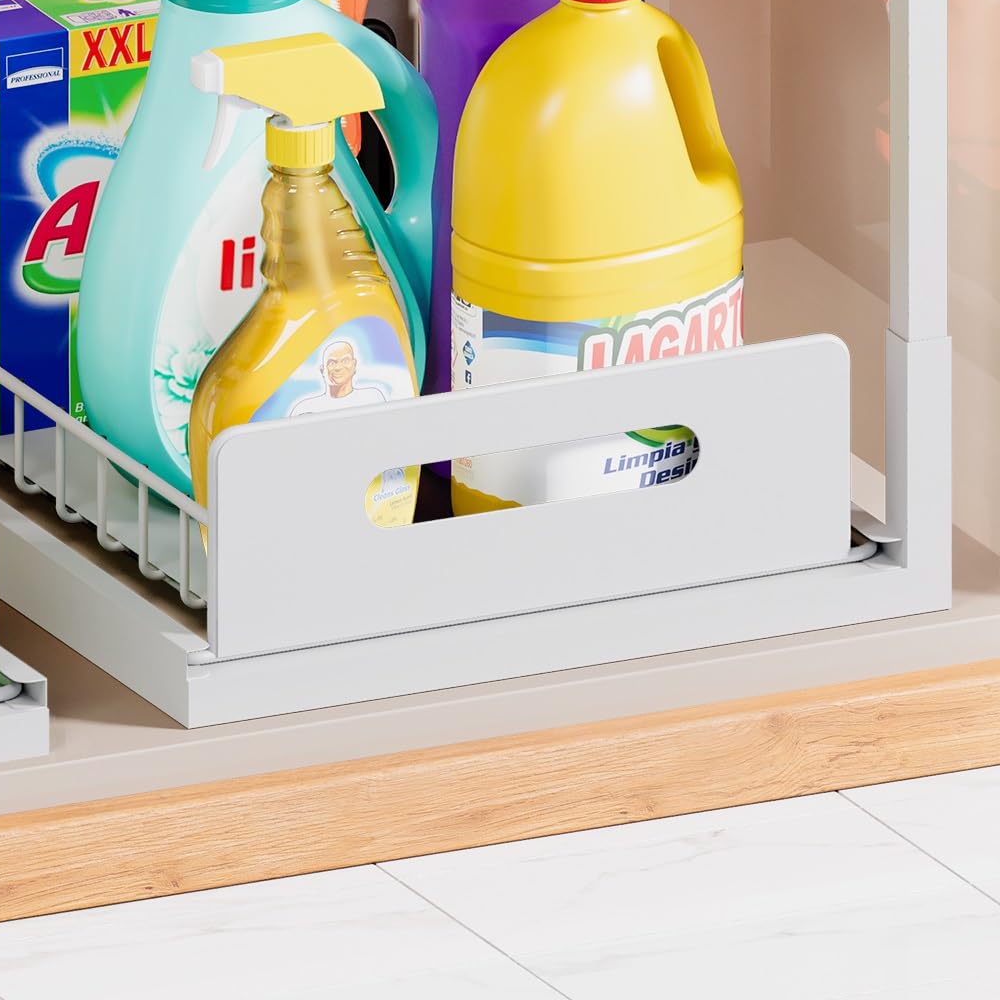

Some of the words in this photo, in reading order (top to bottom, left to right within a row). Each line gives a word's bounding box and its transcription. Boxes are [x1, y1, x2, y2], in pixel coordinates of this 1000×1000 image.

[81, 22, 153, 71] XXL
[10, 69, 61, 84] PROFESSIONAL
[591, 286, 744, 369] LAGART
[604, 441, 686, 475] Limpia
